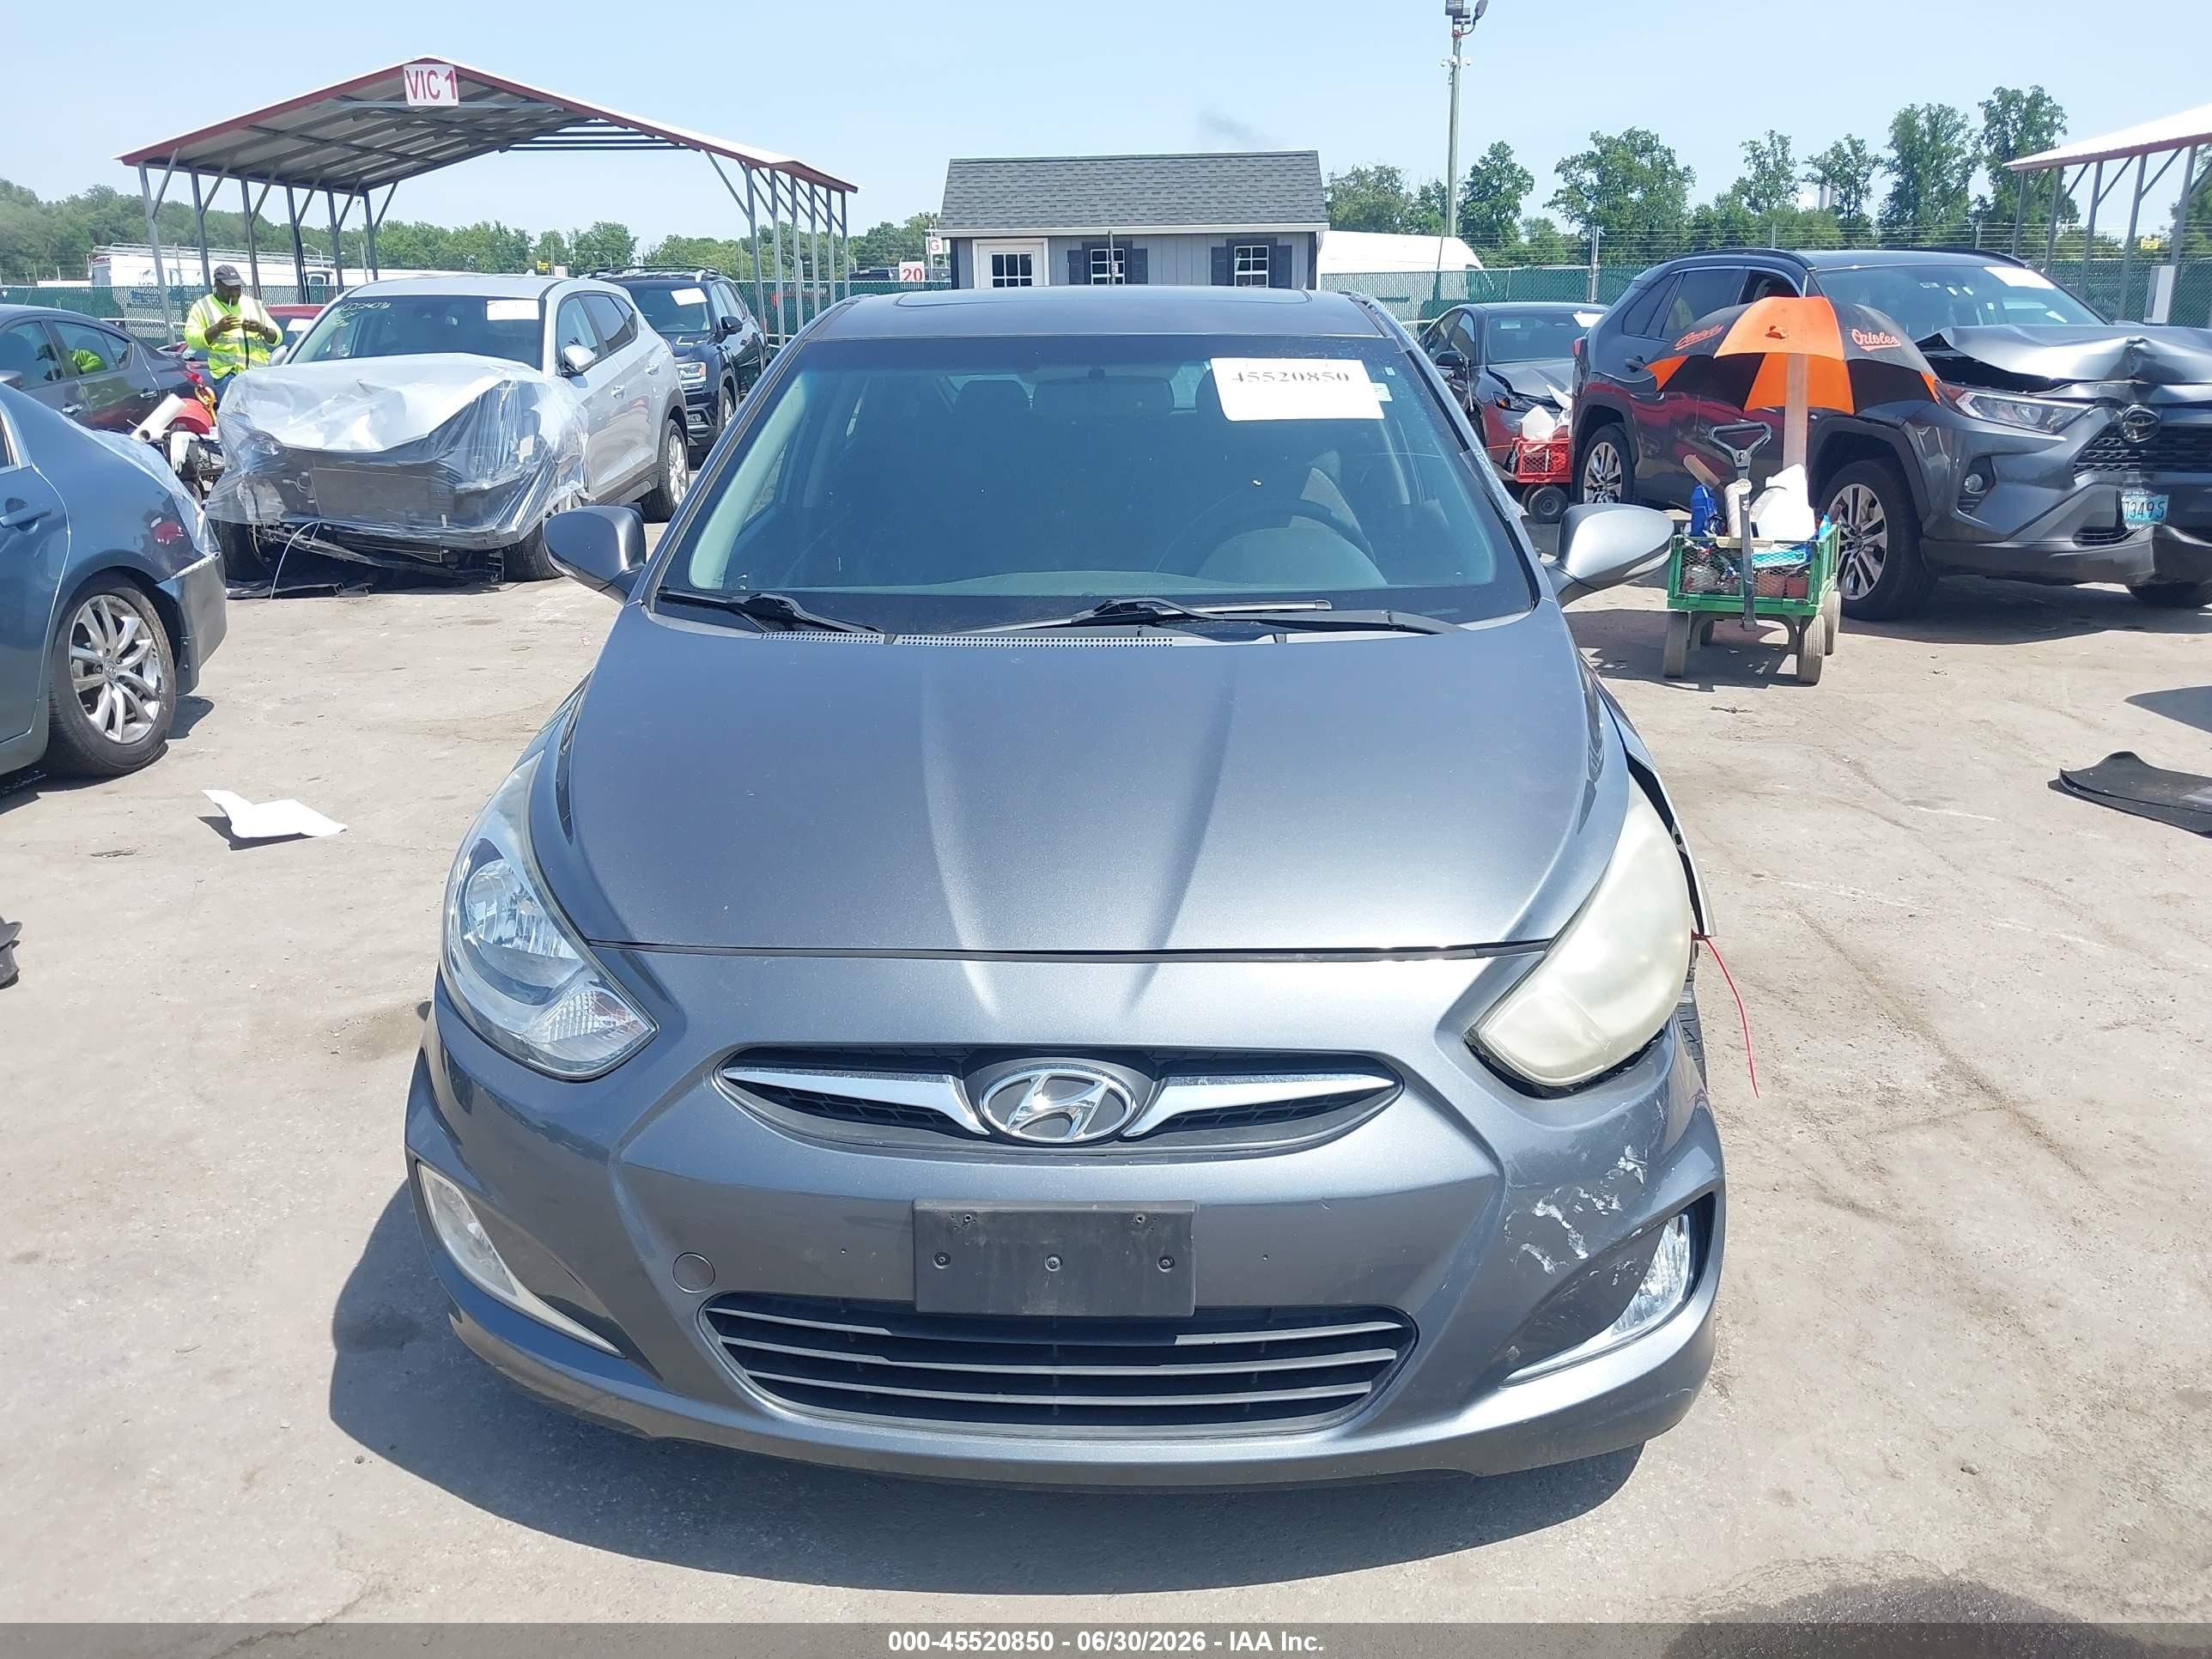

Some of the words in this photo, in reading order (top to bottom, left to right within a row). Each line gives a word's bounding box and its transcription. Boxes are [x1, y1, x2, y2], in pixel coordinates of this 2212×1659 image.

[405, 70, 441, 100] VIC
[445, 70, 456, 100] 1
[930, 240, 940, 252] G
[902, 268, 923, 282] 20
[1851, 329, 1899, 345] Orioles
[1231, 371, 1350, 383] 45520850
